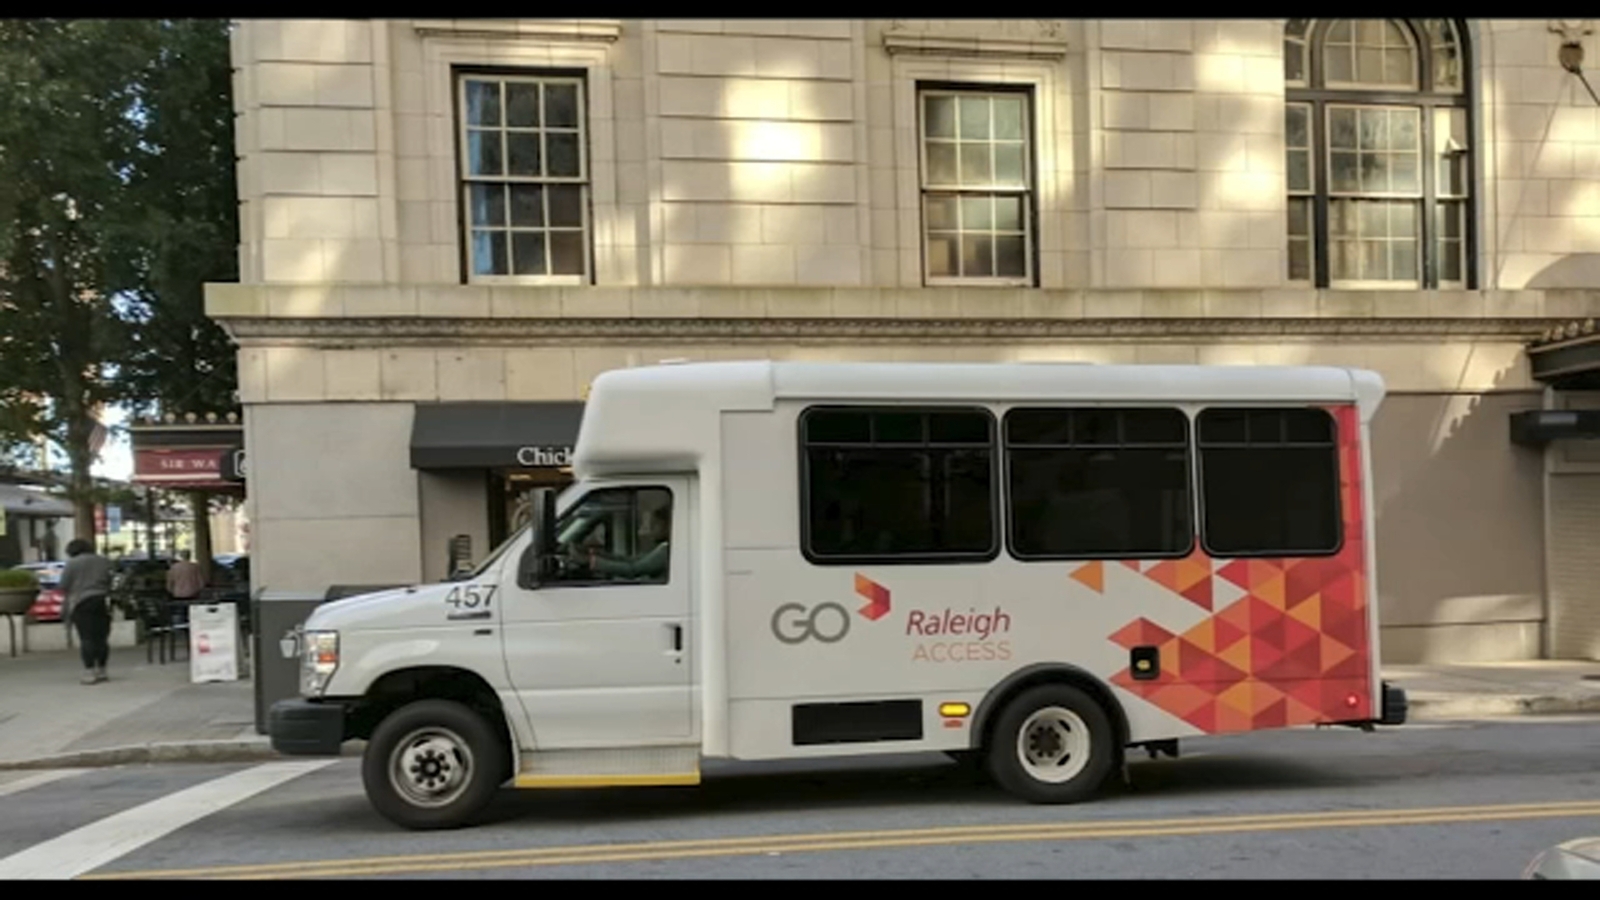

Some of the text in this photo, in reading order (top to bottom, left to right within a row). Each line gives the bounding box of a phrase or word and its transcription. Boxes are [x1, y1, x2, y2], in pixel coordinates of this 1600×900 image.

[445, 584, 498, 608] 457
[771, 602, 850, 644] GO
[906, 606, 1011, 641] Raleigh
[912, 641, 1012, 663] ACCESS
